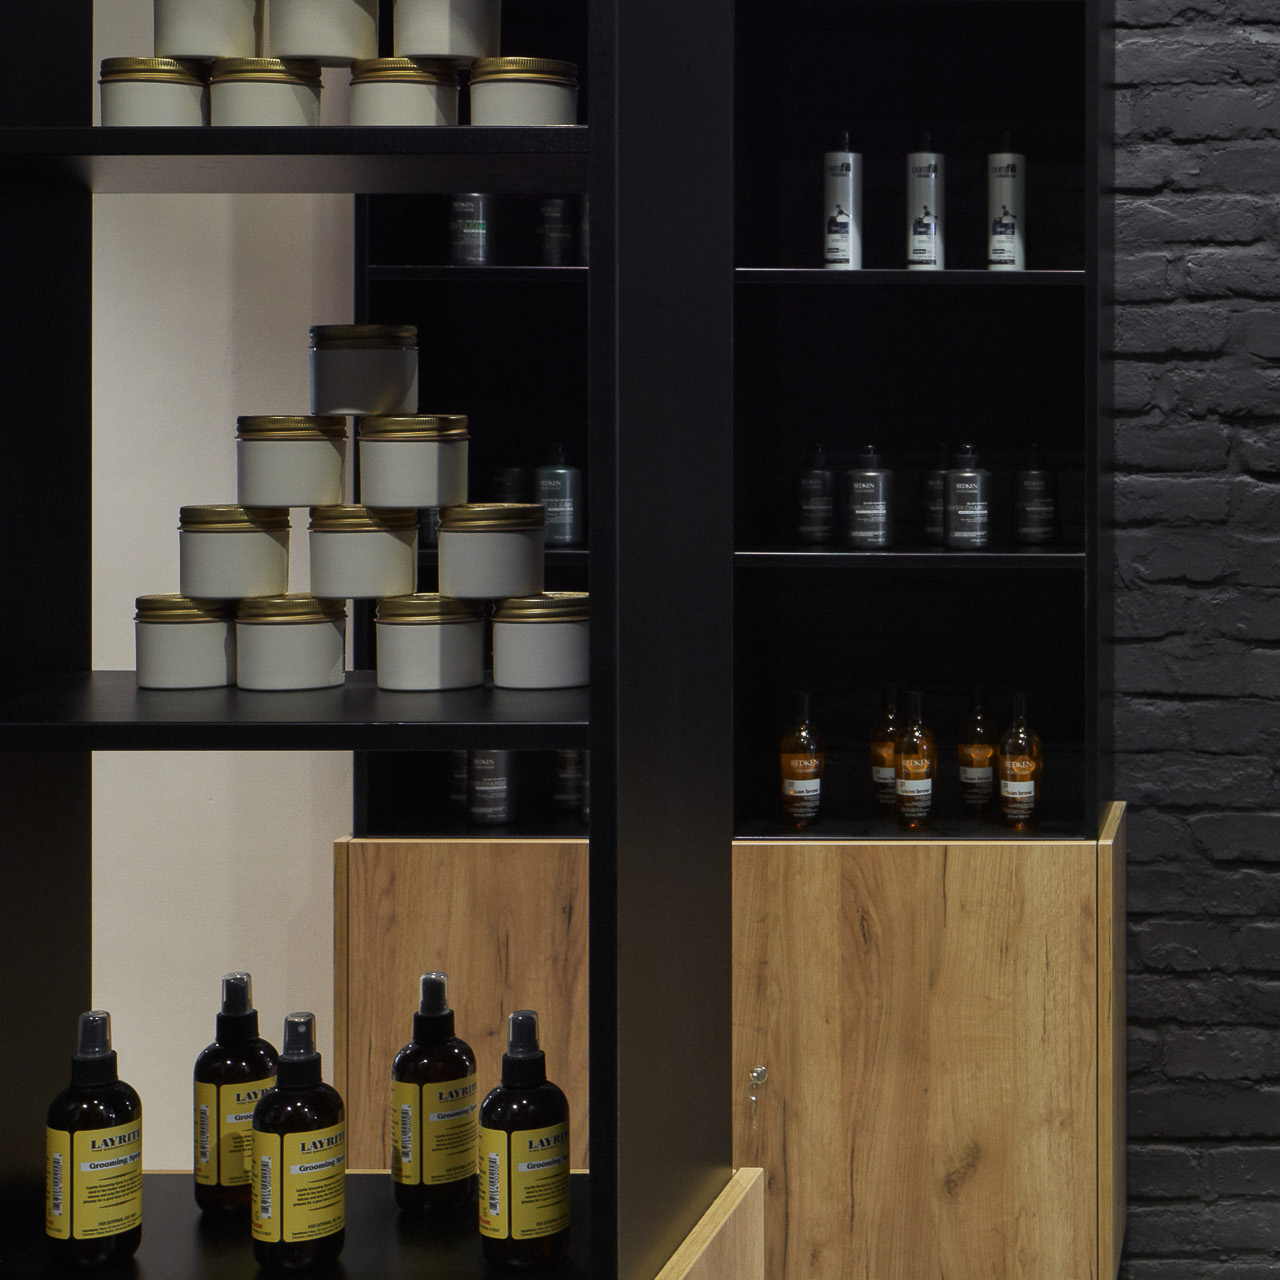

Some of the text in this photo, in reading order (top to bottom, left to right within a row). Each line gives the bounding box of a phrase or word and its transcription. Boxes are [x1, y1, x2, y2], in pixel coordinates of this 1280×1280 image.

[791, 758, 819, 767] REDKEN
[902, 759, 930, 767] REDKEN
[89, 1158, 128, 1169] Grooming
